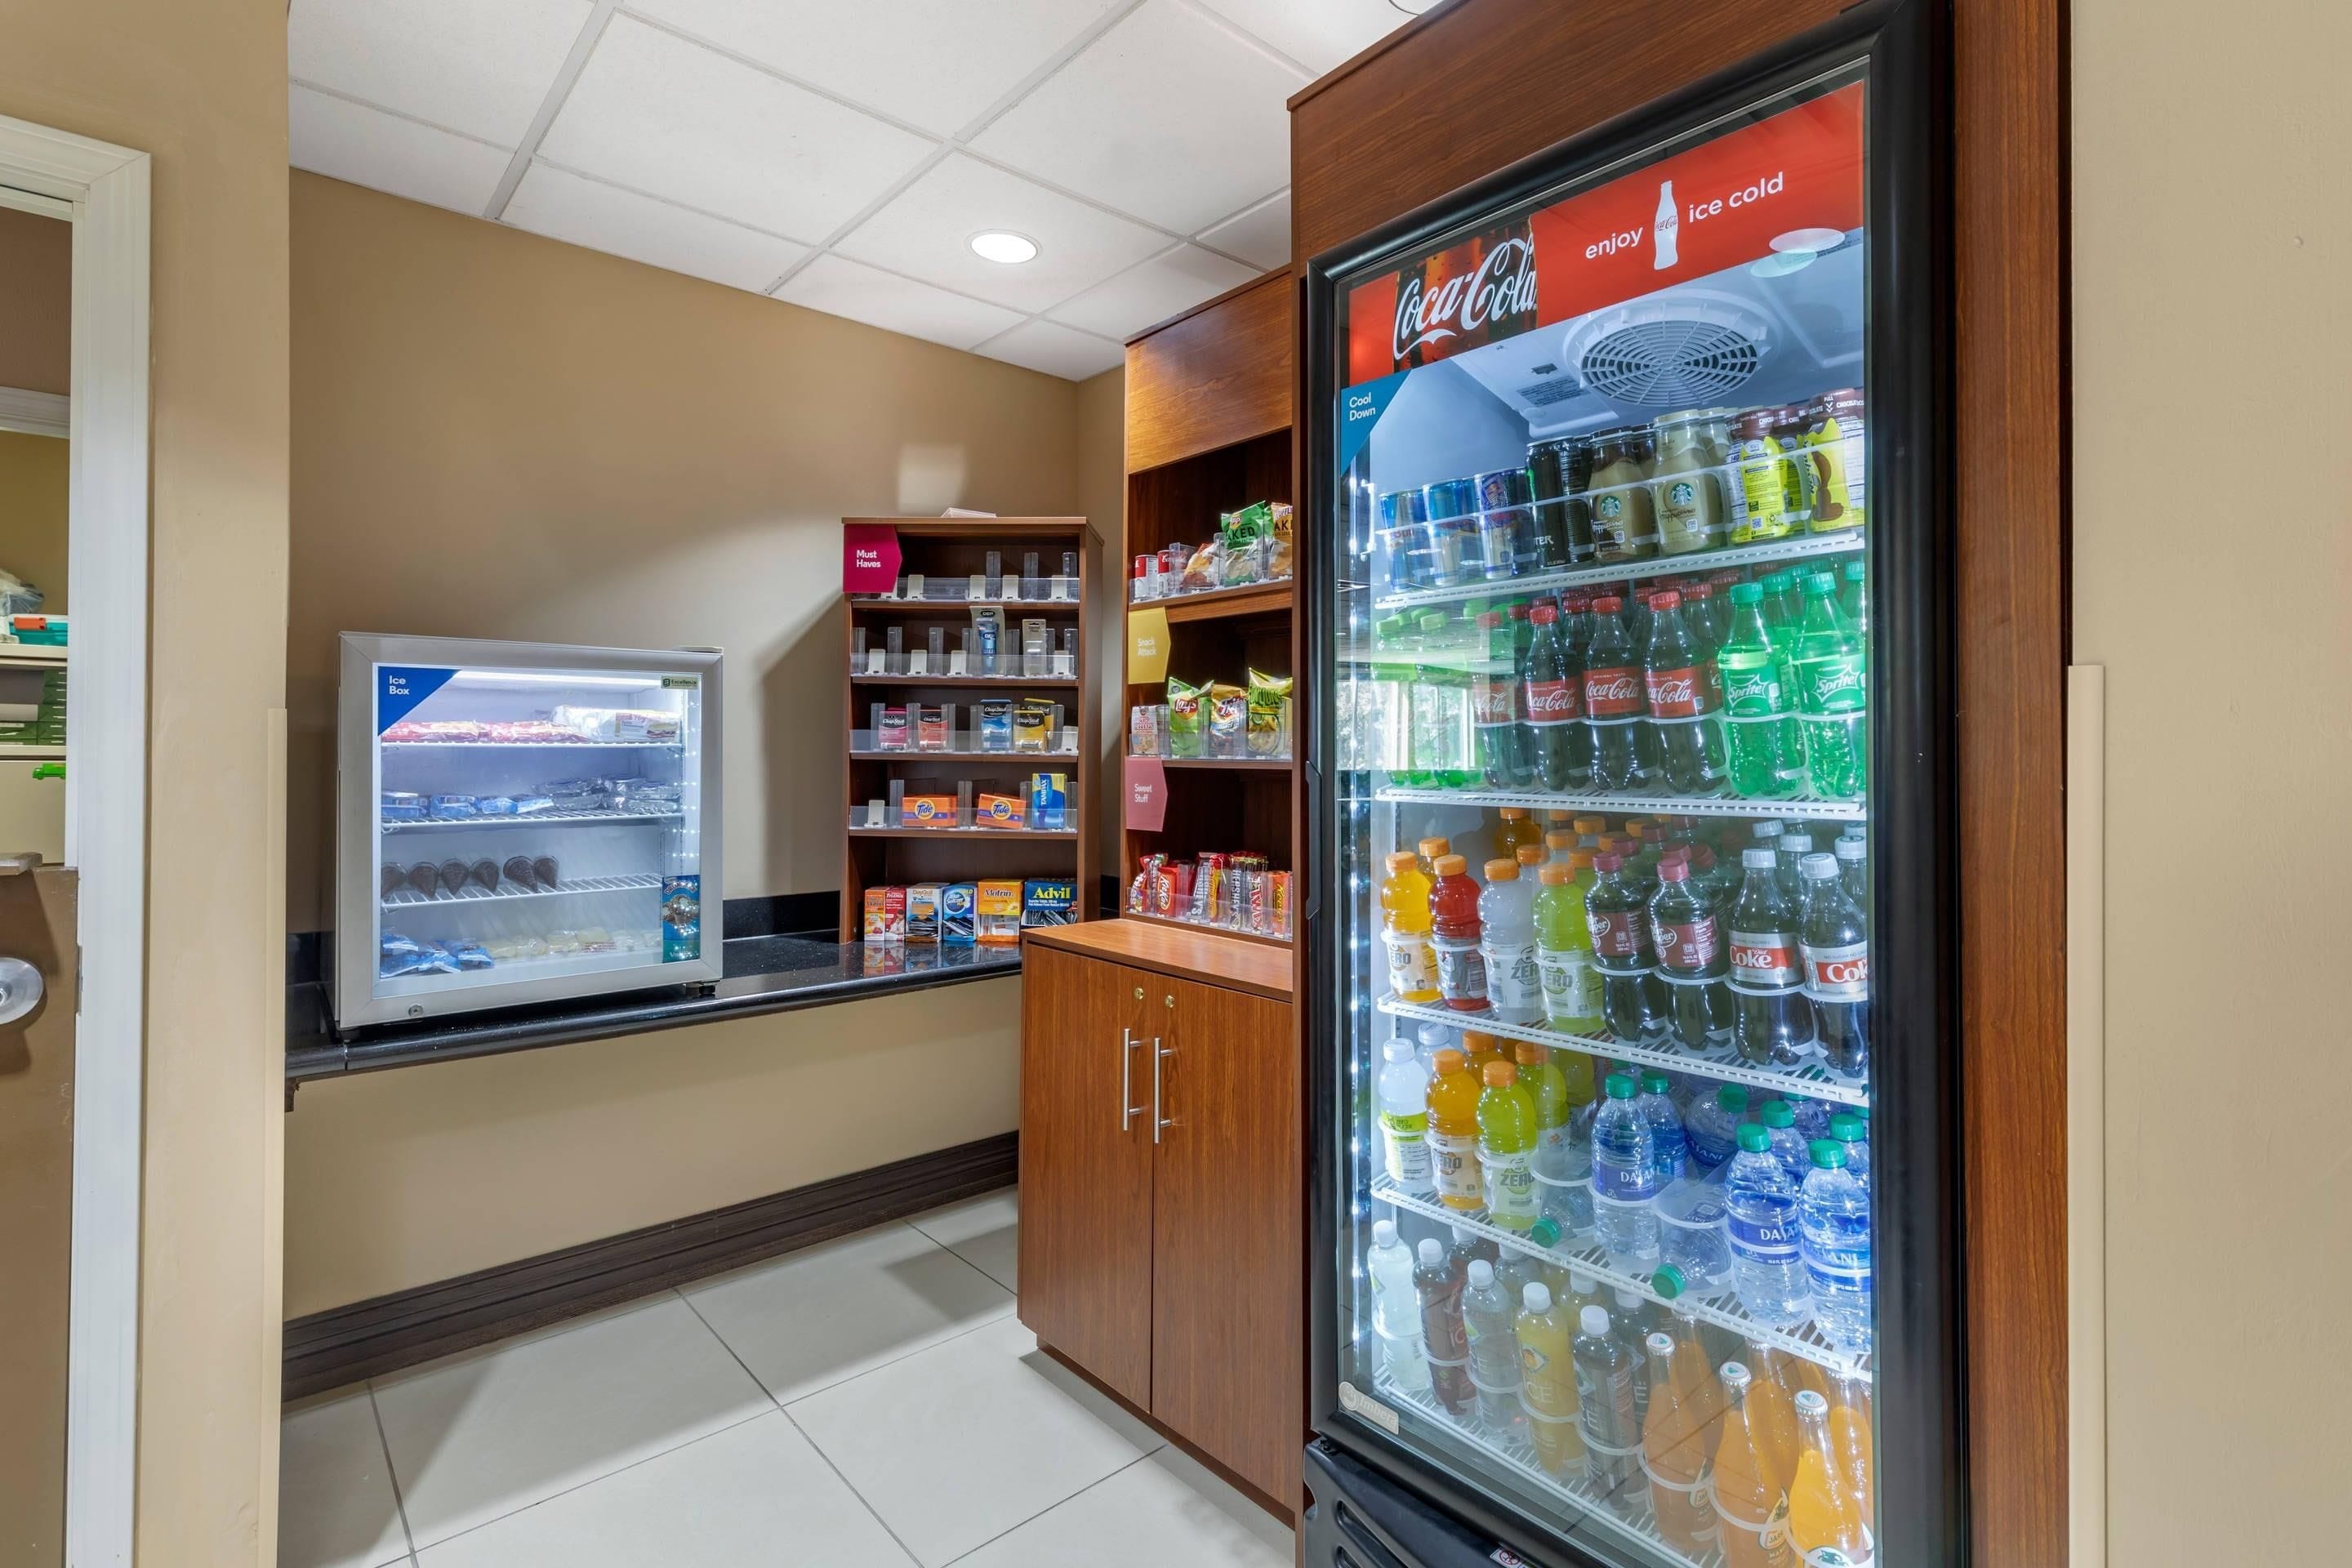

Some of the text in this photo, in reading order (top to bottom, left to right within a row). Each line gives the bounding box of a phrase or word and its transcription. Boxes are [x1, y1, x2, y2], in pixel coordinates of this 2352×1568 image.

[1585, 172, 1784, 260] enjoy ice cold
[1393, 238, 1537, 360] Coca-Cola
[1349, 394, 1371, 408] Cool
[1349, 405, 1375, 421] Down
[856, 550, 877, 559] Must
[856, 559, 881, 568] Haves
[1138, 637, 1156, 647] Snack
[1138, 647, 1156, 657] Attack
[389, 675, 406, 684] Ice
[1818, 674, 1855, 694] Sprite
[389, 685, 410, 695] Box
[1586, 677, 1640, 702] Coca-Cola
[1730, 684, 1762, 699] Sprite
[1176, 698, 1197, 714] Lay's
[1134, 783, 1152, 793] Sweet
[1134, 794, 1148, 803] Stuff
[916, 804, 933, 816] Tide
[993, 804, 1011, 815] Tide
[1033, 886, 1071, 899] Advil
[1730, 946, 1772, 969] Coke
[1509, 963, 1540, 980] ZER
[1827, 960, 1868, 982] Cok
[1359, 1396, 1397, 1425] Imbera
